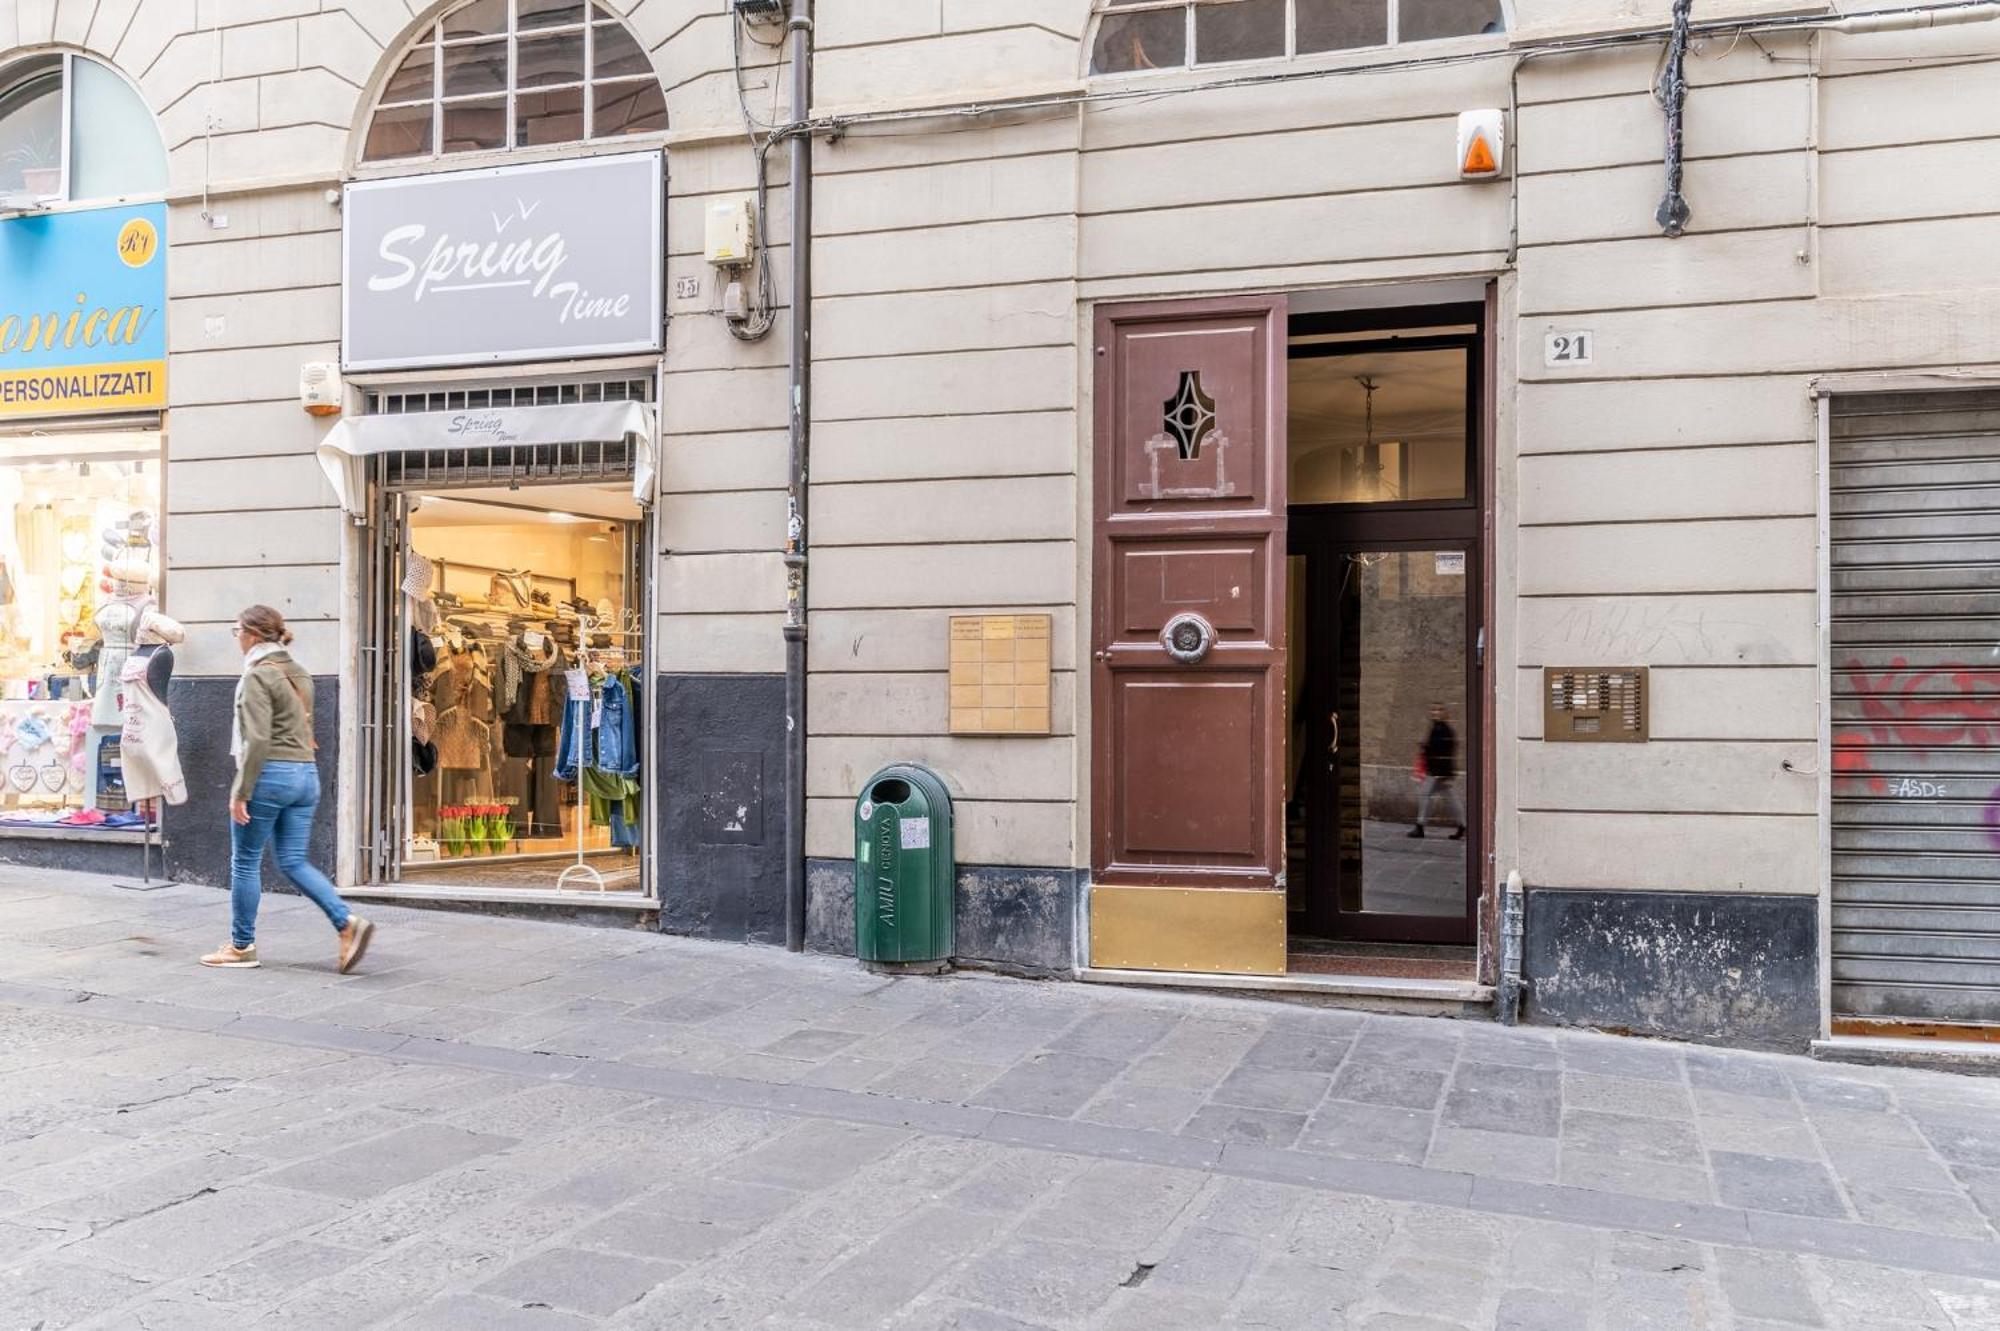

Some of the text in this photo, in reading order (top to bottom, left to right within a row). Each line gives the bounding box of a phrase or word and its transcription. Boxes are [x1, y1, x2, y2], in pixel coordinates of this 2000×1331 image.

[367, 223, 568, 302] Spring
[549, 281, 630, 324] Time
[1553, 335, 1590, 361] 21
[0, 371, 152, 402] ERSONALIZZATI
[448, 415, 502, 436] Spring
[879, 817, 895, 927] AMIU GENOVA
